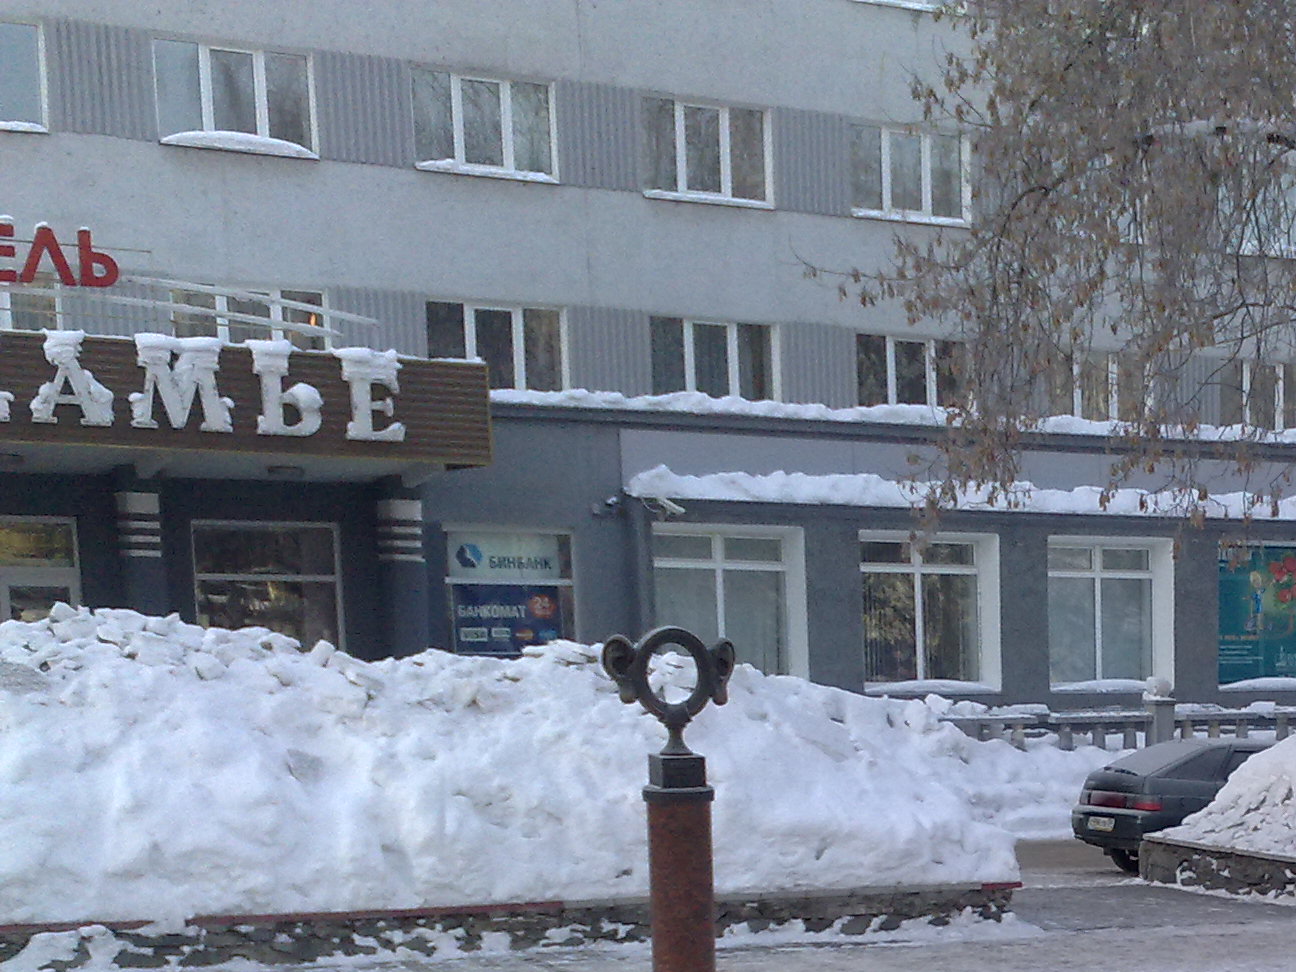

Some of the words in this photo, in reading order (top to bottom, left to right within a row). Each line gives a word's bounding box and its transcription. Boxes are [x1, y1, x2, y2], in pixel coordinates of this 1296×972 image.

[0, 329, 407, 442] АМЬЕ
[488, 555, 553, 570] БИНБАНК
[456, 604, 526, 618] БАНКОМАТ
